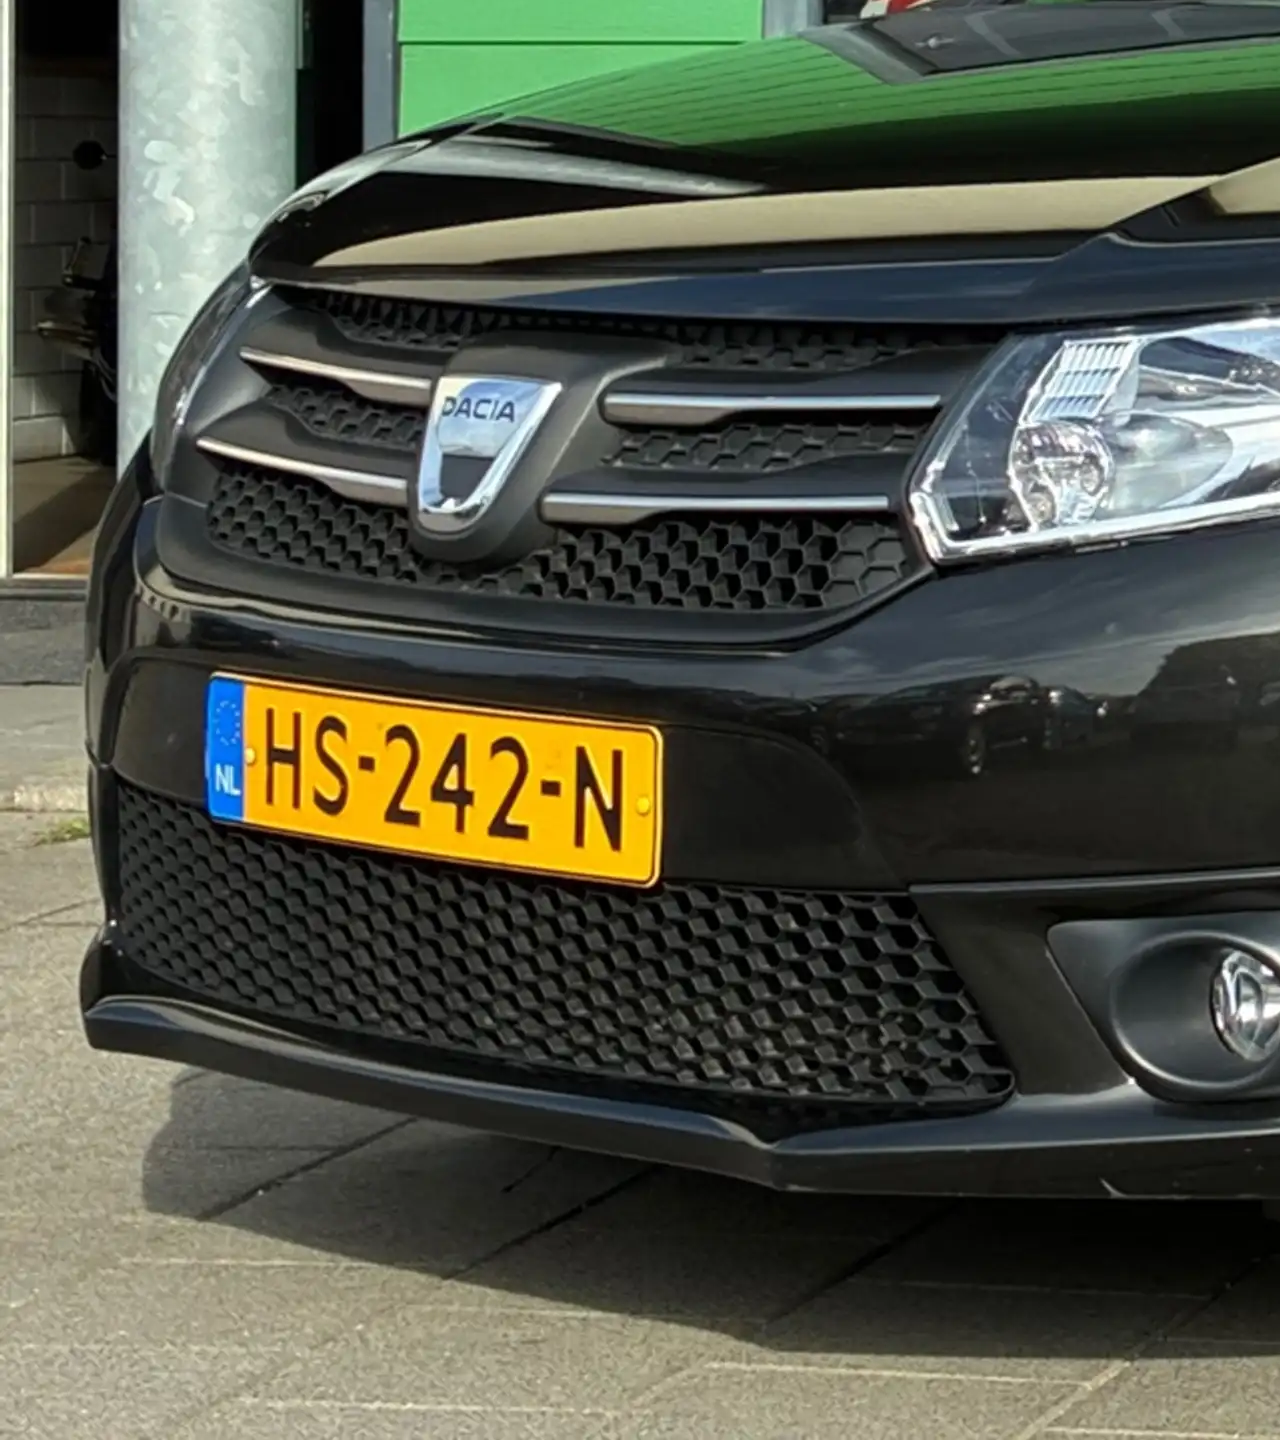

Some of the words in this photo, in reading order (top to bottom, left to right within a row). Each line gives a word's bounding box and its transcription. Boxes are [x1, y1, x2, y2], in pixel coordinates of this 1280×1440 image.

[441, 395, 516, 423] DACIA
[214, 763, 241, 797] NL
[265, 707, 624, 852] HS-242-N
